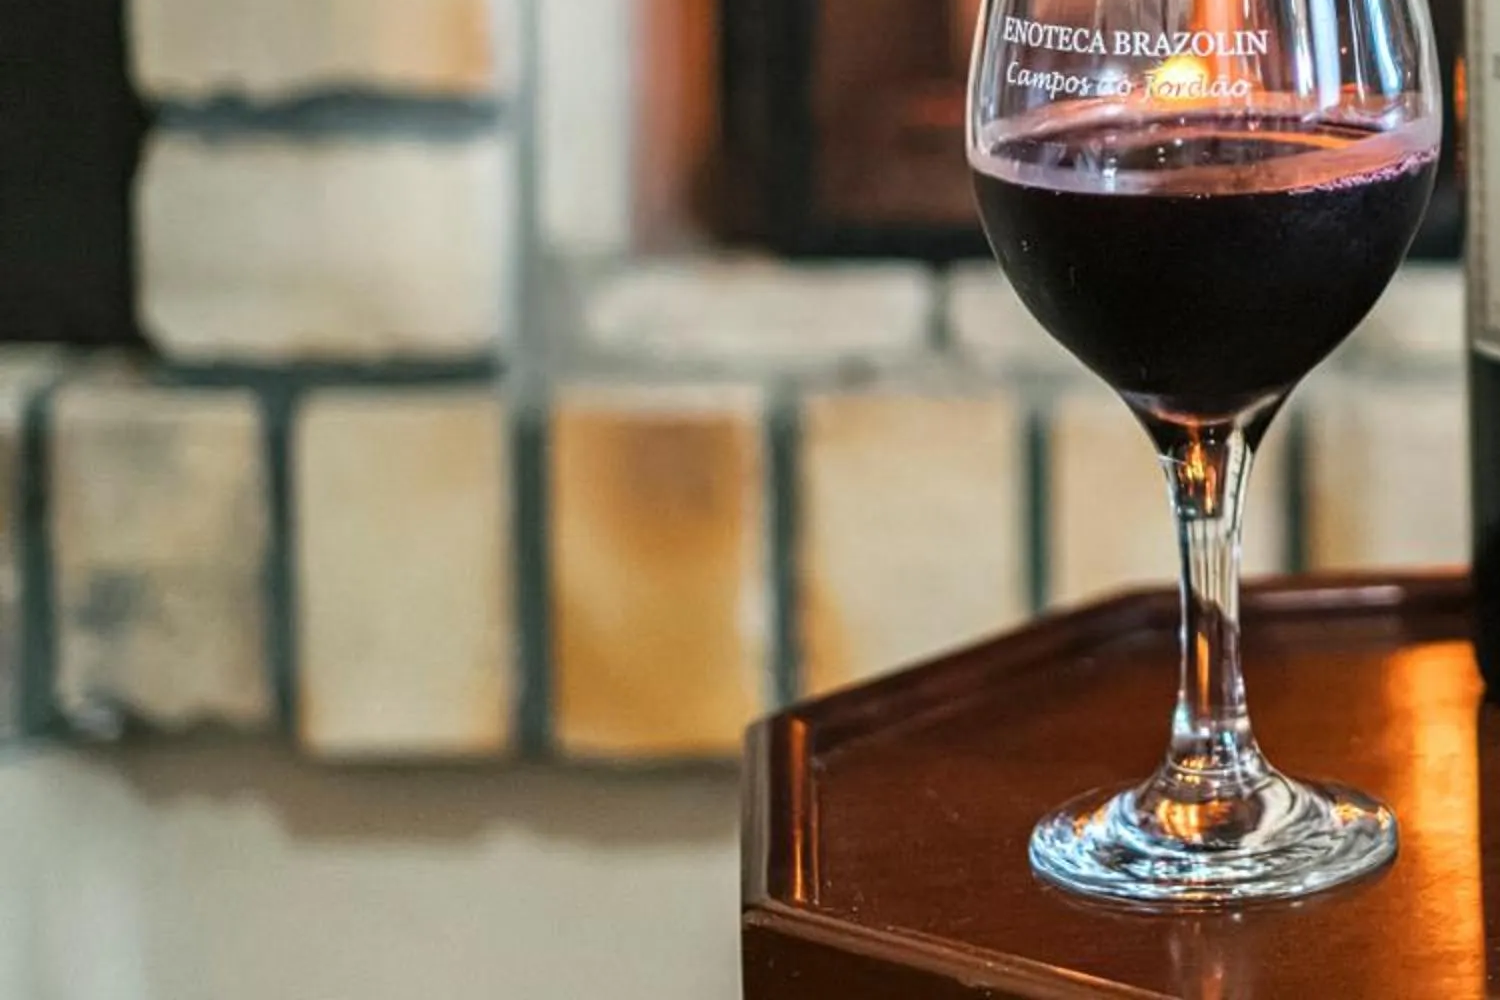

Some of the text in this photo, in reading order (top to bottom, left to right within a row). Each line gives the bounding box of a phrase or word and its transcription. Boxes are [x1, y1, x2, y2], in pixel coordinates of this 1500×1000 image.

[1003, 16, 1269, 56] ENOTECA BRAZOLIN
[1006, 61, 1091, 99] Campos
[1097, 70, 1132, 97] do
